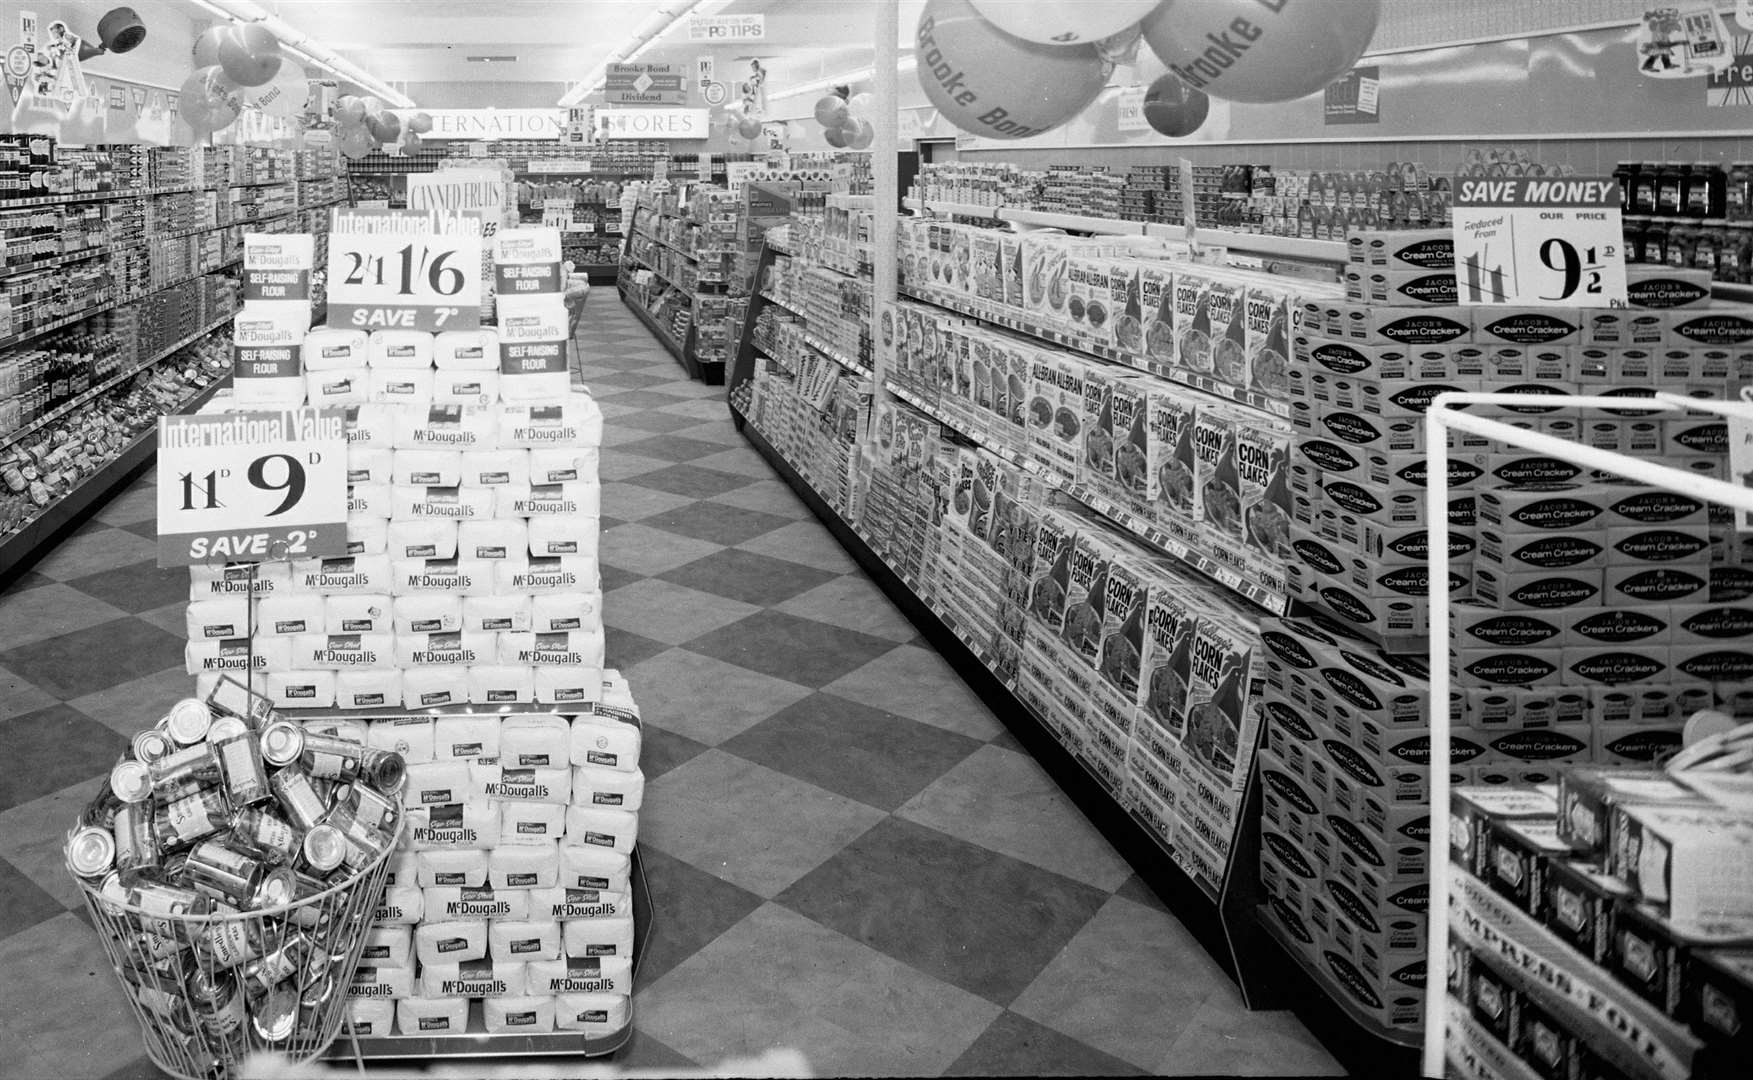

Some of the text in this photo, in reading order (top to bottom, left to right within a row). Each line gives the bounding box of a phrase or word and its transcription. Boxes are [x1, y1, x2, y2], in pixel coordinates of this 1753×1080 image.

[731, 24, 762, 37] TIPS
[614, 64, 670, 73] Brooke Bond
[918, 16, 977, 107] Brooke
[621, 92, 662, 101] Dividend
[1460, 181, 1613, 203] SAVE MONEY
[332, 208, 480, 235] International Value
[1464, 216, 1504, 231] Reduced
[1474, 230, 1496, 239] from
[261, 286, 285, 297] FLOUR
[516, 280, 540, 290] FLOUR
[351, 308, 416, 326] SAVE
[1248, 302, 1271, 320] CORN
[1387, 327, 1461, 336] Cream Crackers
[1493, 326, 1568, 335] Cream Crackers
[1682, 327, 1716, 336] Cream
[253, 363, 278, 373] FLOUR
[522, 359, 546, 369] FLOUR
[1113, 396, 1133, 416] CORN
[1158, 410, 1177, 431] CORN
[161, 408, 343, 449] International Value
[513, 426, 576, 441] McDougall's
[413, 429, 476, 444] McDougall's
[1238, 444, 1269, 470] CORN
[1239, 461, 1268, 487] FLAKES
[1501, 468, 1574, 477] Cream Crackers
[514, 500, 576, 514] McDougall's
[1618, 503, 1696, 514] Cream Crackers
[1519, 509, 1595, 521] Cream Crackers
[190, 533, 269, 559] SAVE
[1520, 547, 1595, 560] Cream Crackers
[1073, 550, 1094, 577] CORN
[305, 573, 369, 588] McDougall's
[408, 574, 471, 589] McDougall's
[513, 573, 576, 588] McDougall's
[1108, 577, 1132, 604] CORN
[1518, 588, 1590, 601] Cream Crackers
[1153, 606, 1178, 636] CORN
[1475, 627, 1551, 637] Cream Crackers
[313, 650, 377, 665] McDougall's
[1195, 636, 1223, 671] CORN
[1192, 656, 1220, 690] FLAKES
[1579, 665, 1657, 674] Cream Crackers
[485, 783, 549, 799] McDougall's
[413, 828, 477, 844] McDougall's
[446, 901, 511, 917] McDougall's
[552, 903, 616, 918] McDougall's
[442, 979, 507, 997] McDougall's
[550, 978, 614, 993] McDougall's
